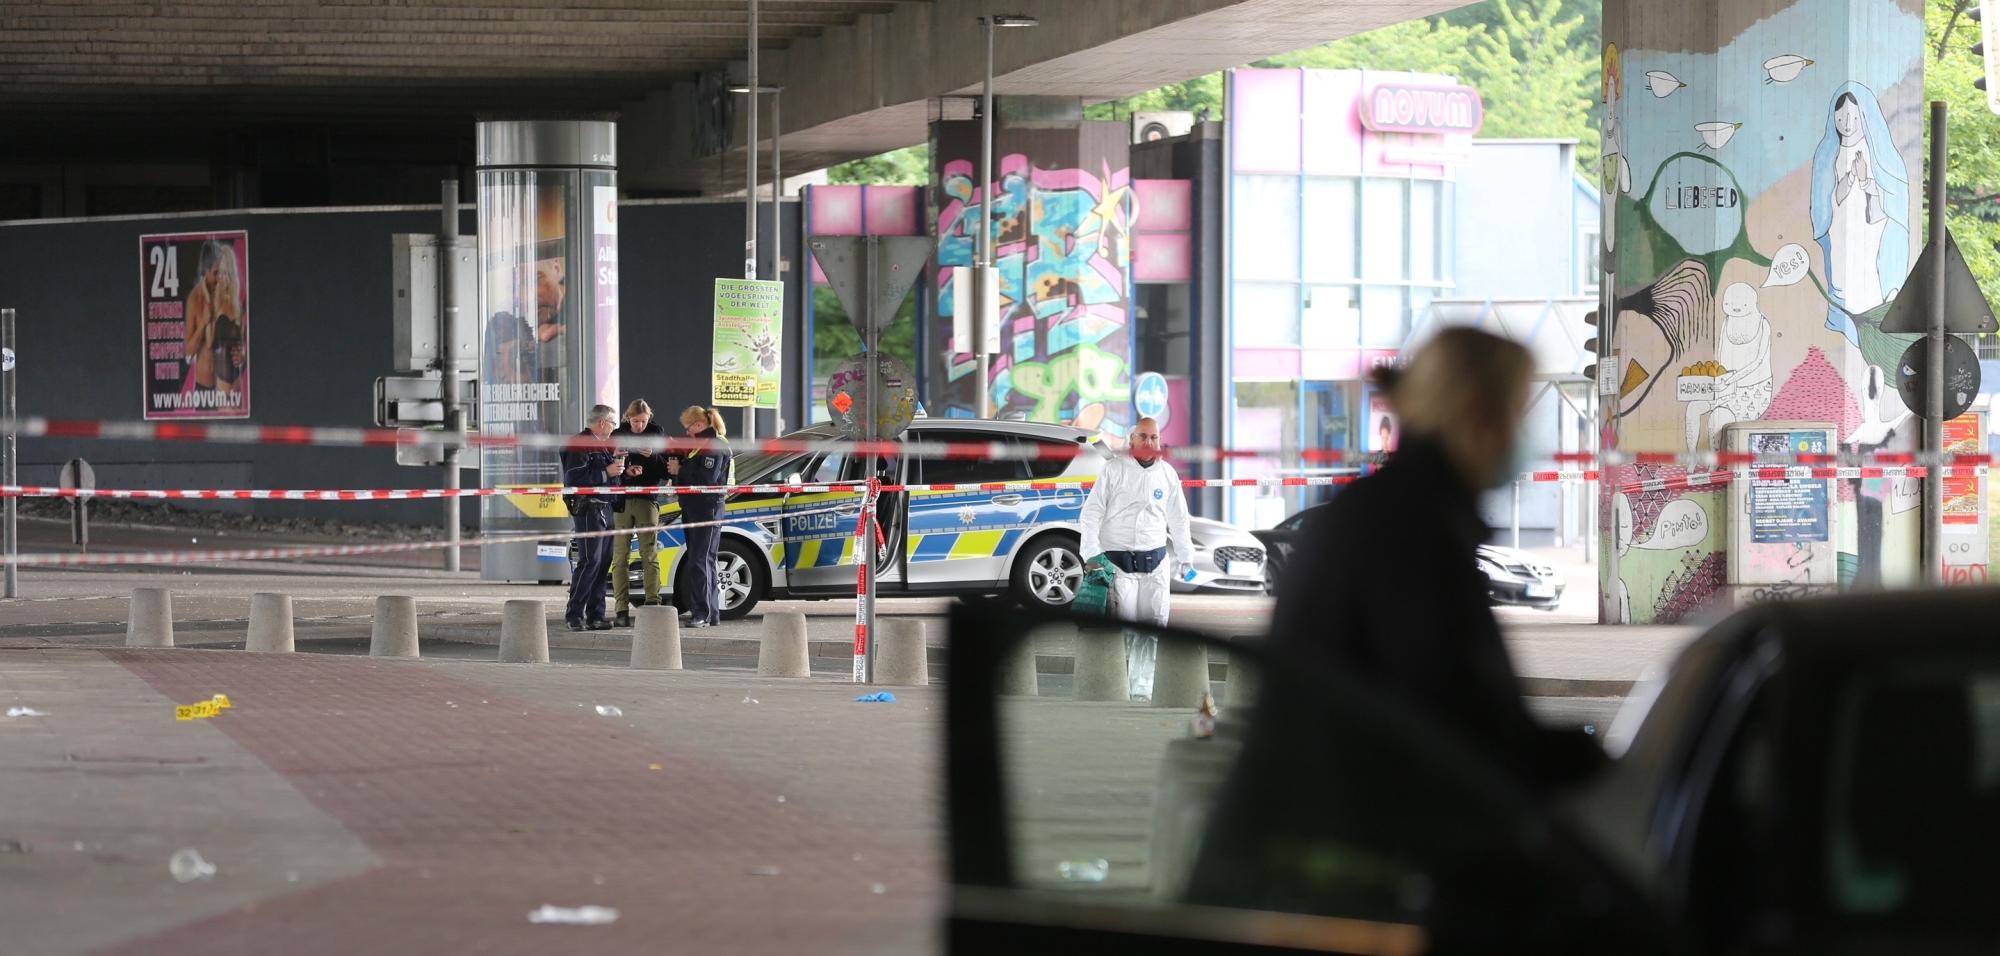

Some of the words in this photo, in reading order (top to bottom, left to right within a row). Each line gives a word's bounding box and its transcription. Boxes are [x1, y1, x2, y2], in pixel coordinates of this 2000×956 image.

[150, 246, 180, 298] 24
[719, 292, 780, 301] VOGELSPINNEN
[790, 513, 837, 532] POLIZEI
[177, 708, 192, 718] 32
